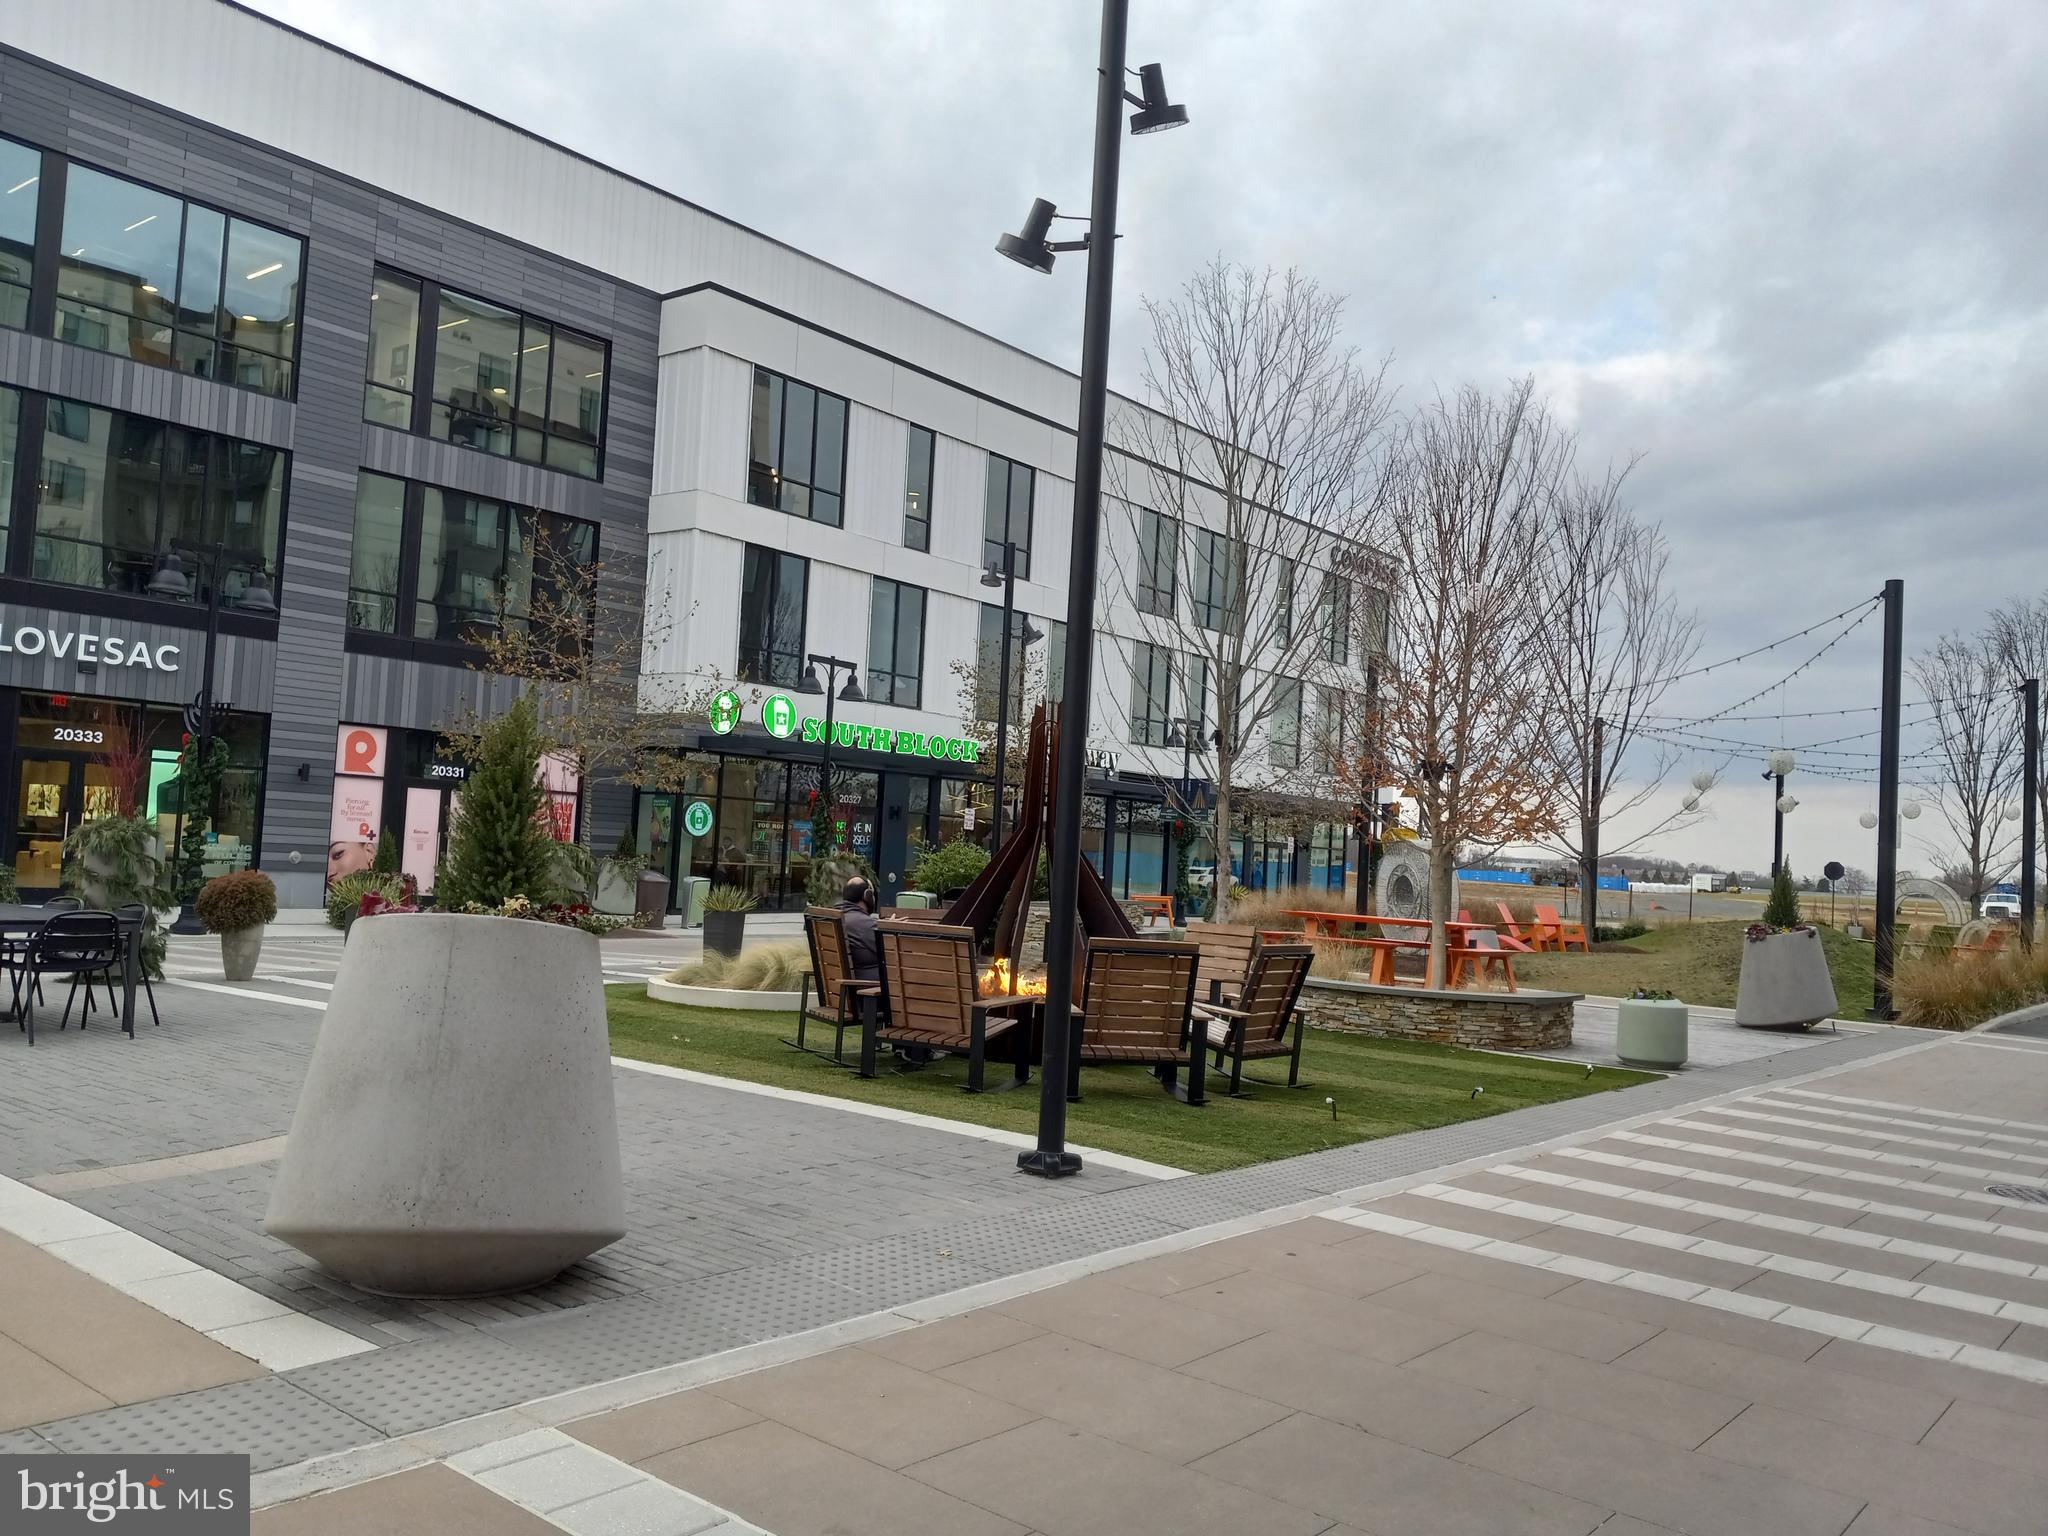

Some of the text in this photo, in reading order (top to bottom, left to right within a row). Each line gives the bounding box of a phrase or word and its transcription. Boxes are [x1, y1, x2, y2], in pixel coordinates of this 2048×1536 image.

[53, 727, 103, 744] 20333
[802, 716, 981, 763] SOUTH BLOCK
[1085, 748, 1121, 777] way
[431, 765, 463, 778] 20331
[839, 794, 862, 804] 20327
[864, 823, 872, 833] IN
